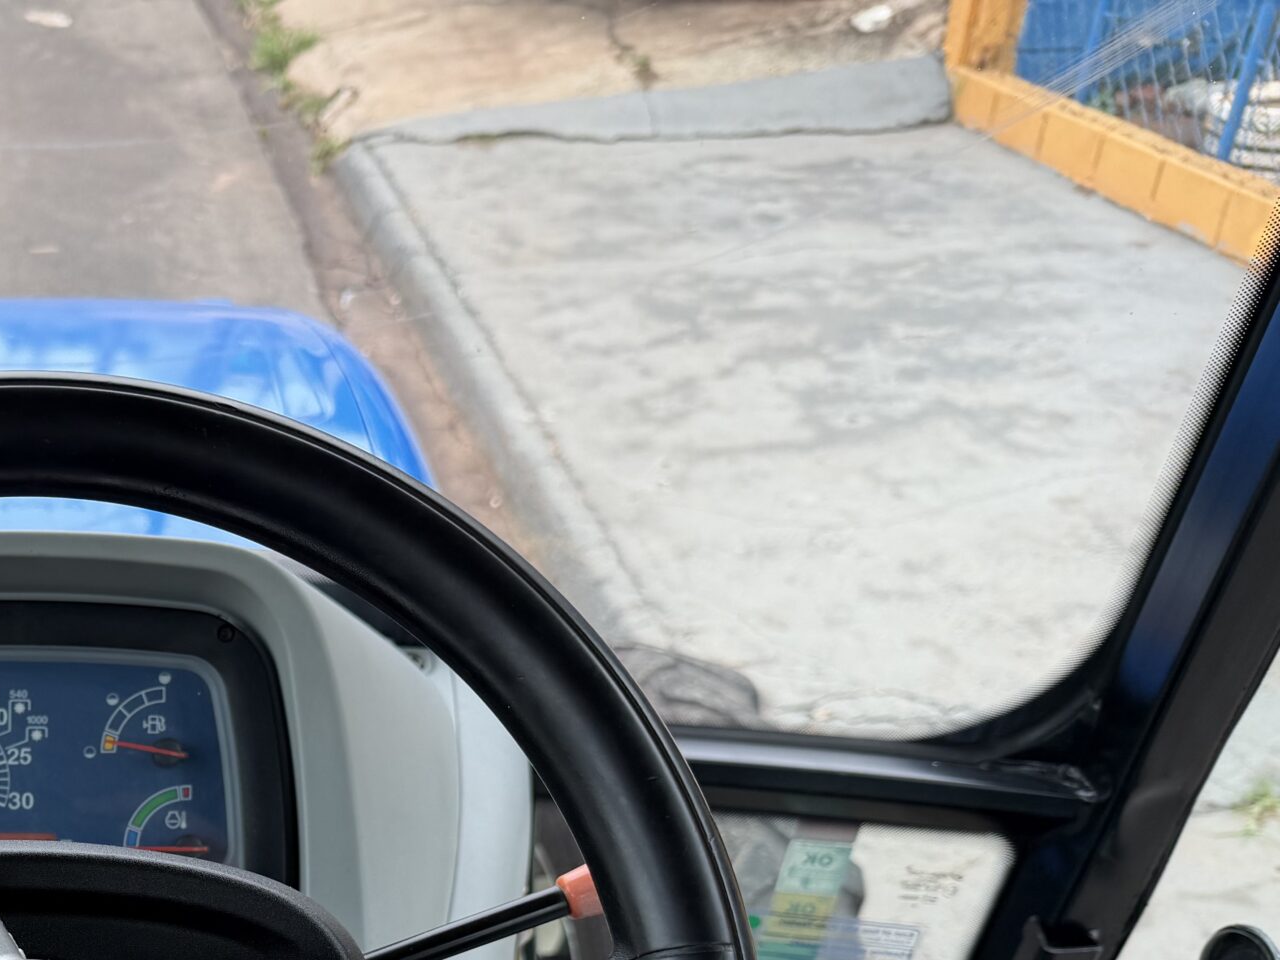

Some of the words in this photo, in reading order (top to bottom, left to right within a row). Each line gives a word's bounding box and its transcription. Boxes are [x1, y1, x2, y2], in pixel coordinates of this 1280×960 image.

[9, 690, 28, 699] 540
[26, 716, 48, 725] 1000
[7, 748, 32, 765] 25
[8, 792, 34, 809] 30
